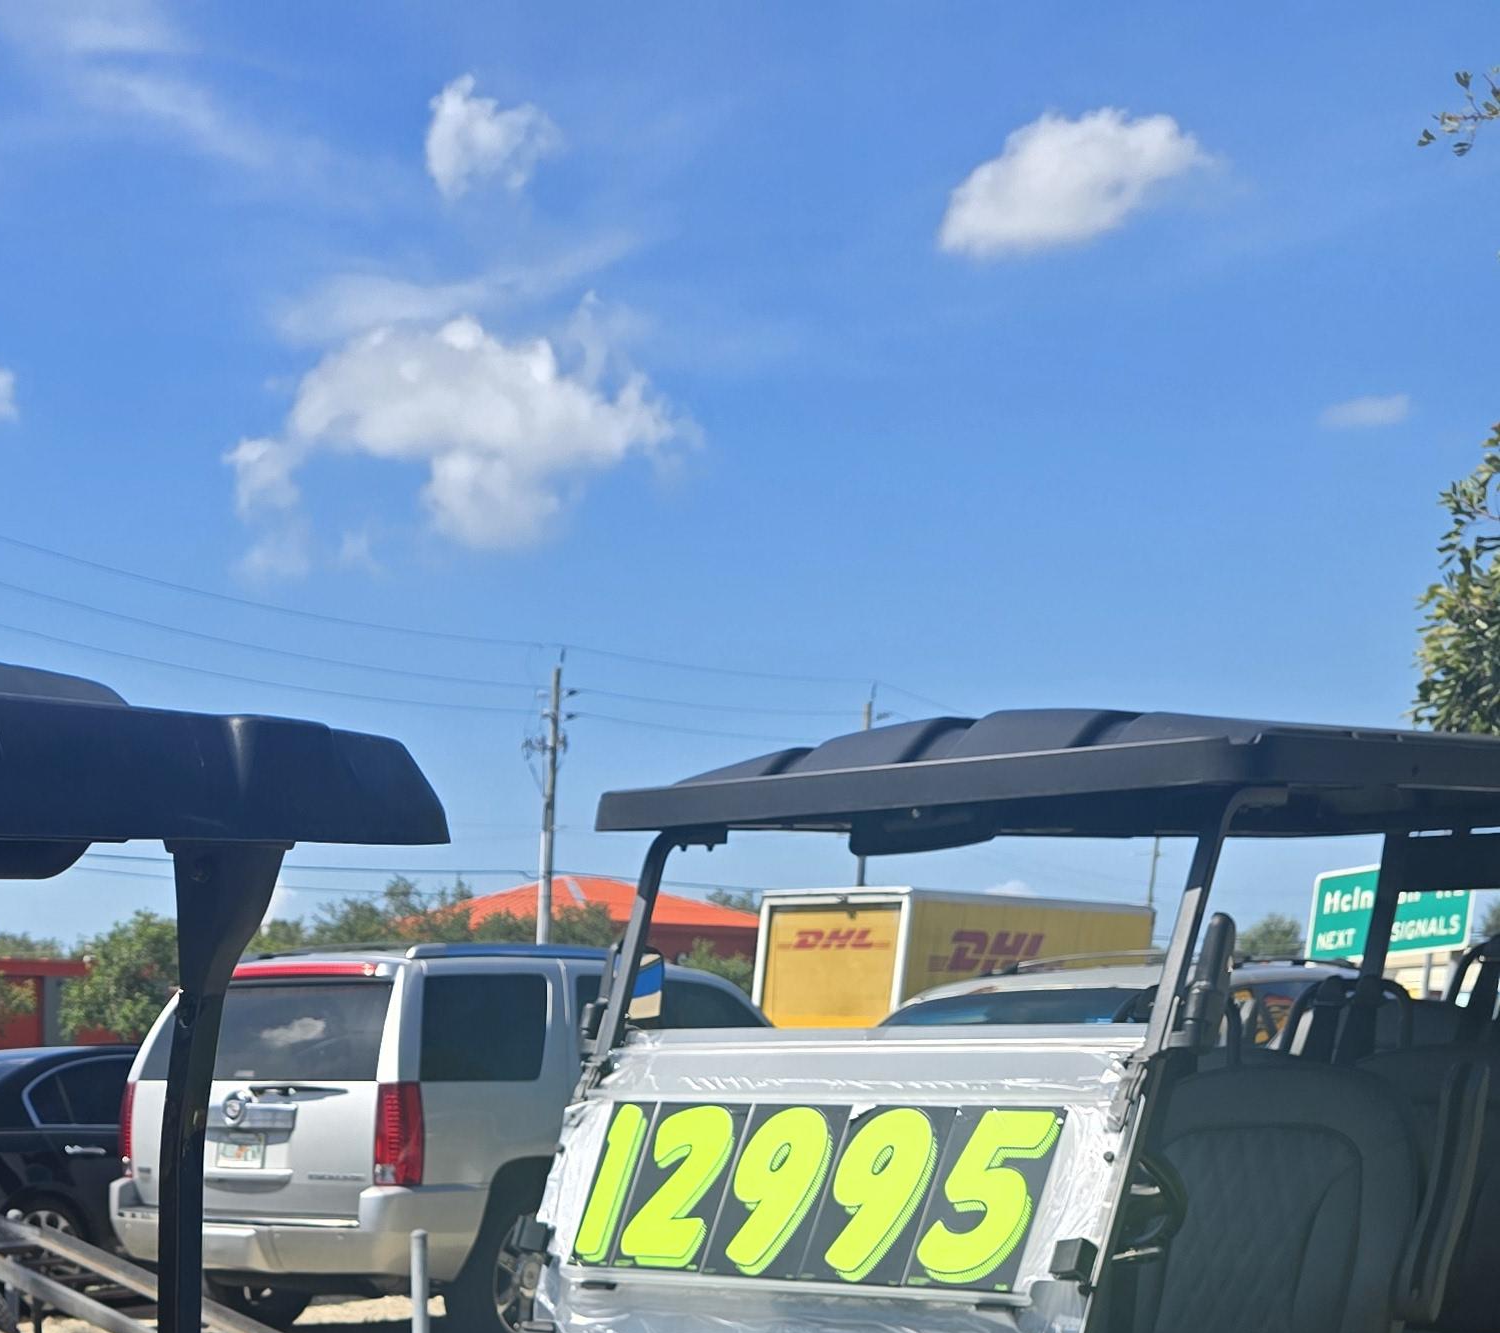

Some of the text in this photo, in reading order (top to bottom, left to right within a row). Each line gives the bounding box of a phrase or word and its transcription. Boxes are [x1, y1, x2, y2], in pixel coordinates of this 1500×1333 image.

[794, 928, 873, 949] DHL
[1316, 914, 1461, 951] NEXT SIGNALS
[574, 1103, 1062, 1284] 12995
